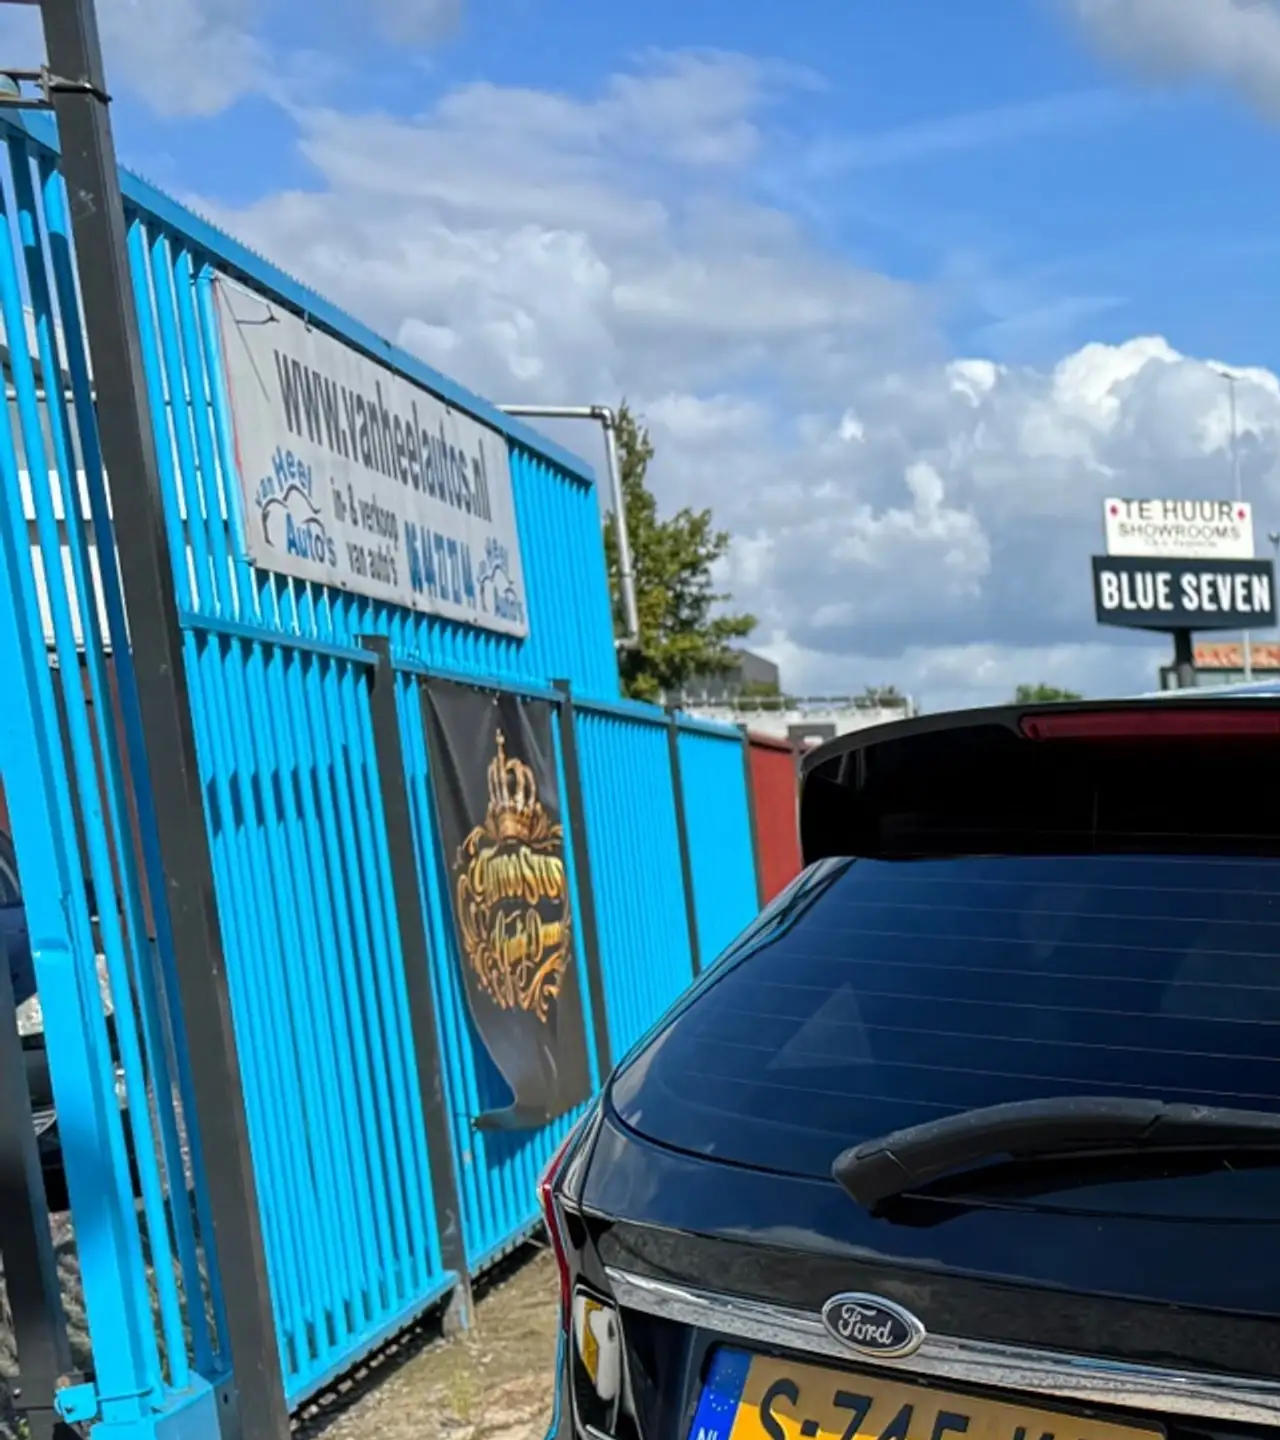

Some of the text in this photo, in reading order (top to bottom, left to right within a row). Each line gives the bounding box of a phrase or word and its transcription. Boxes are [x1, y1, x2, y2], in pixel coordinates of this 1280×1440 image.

[274, 348, 492, 523] www.vanheelautos.nl
[271, 445, 313, 500] Heel
[358, 493, 399, 550] verkoop
[1118, 522, 1241, 540] SHOWROOMS
[1121, 498, 1234, 522] TE HUUR
[1100, 570, 1271, 613] BLUE SEVEN
[837, 1303, 894, 1345] Ford
